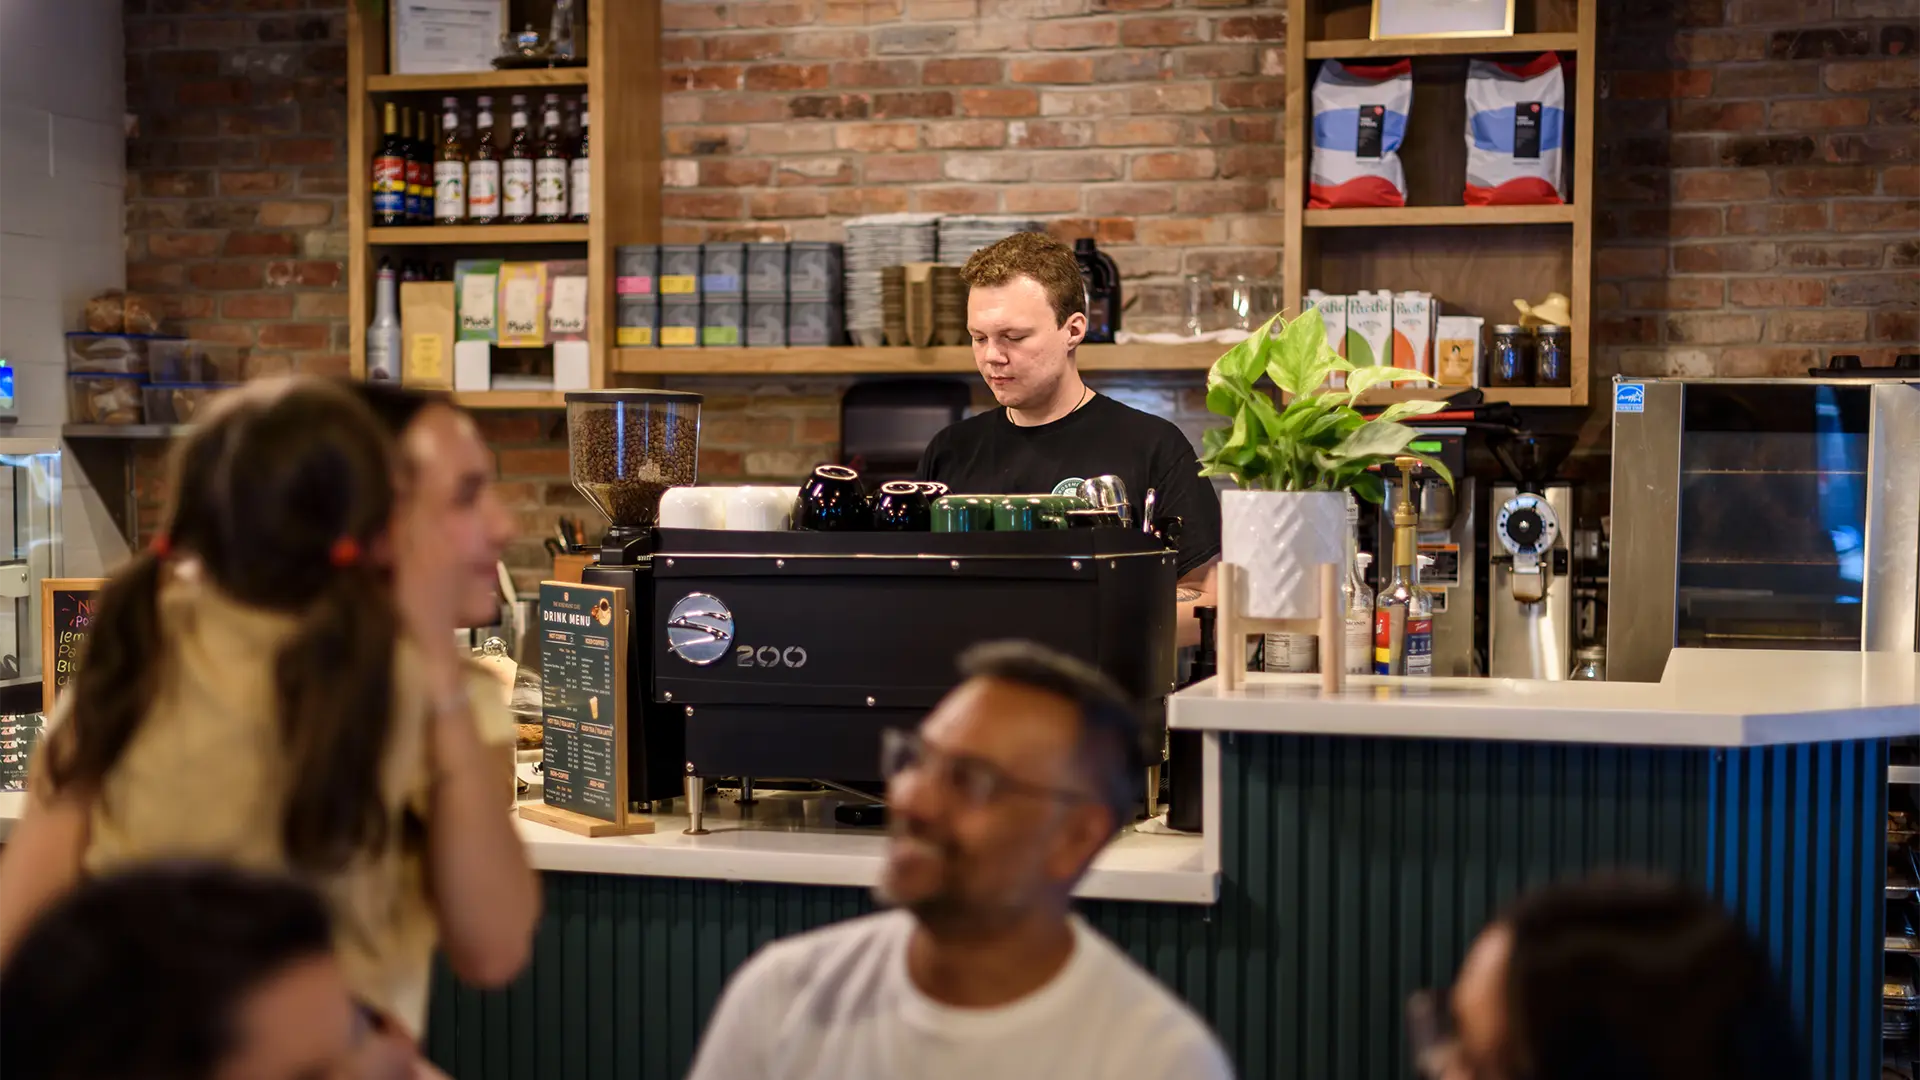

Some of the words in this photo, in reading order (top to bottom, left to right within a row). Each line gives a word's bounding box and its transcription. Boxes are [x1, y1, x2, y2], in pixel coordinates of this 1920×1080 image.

[1350, 299, 1389, 315] Pacific
[1396, 302, 1426, 315] Pacific
[544, 611, 567, 623] DRINK
[569, 614, 590, 626] MENU
[736, 645, 808, 668] 200
